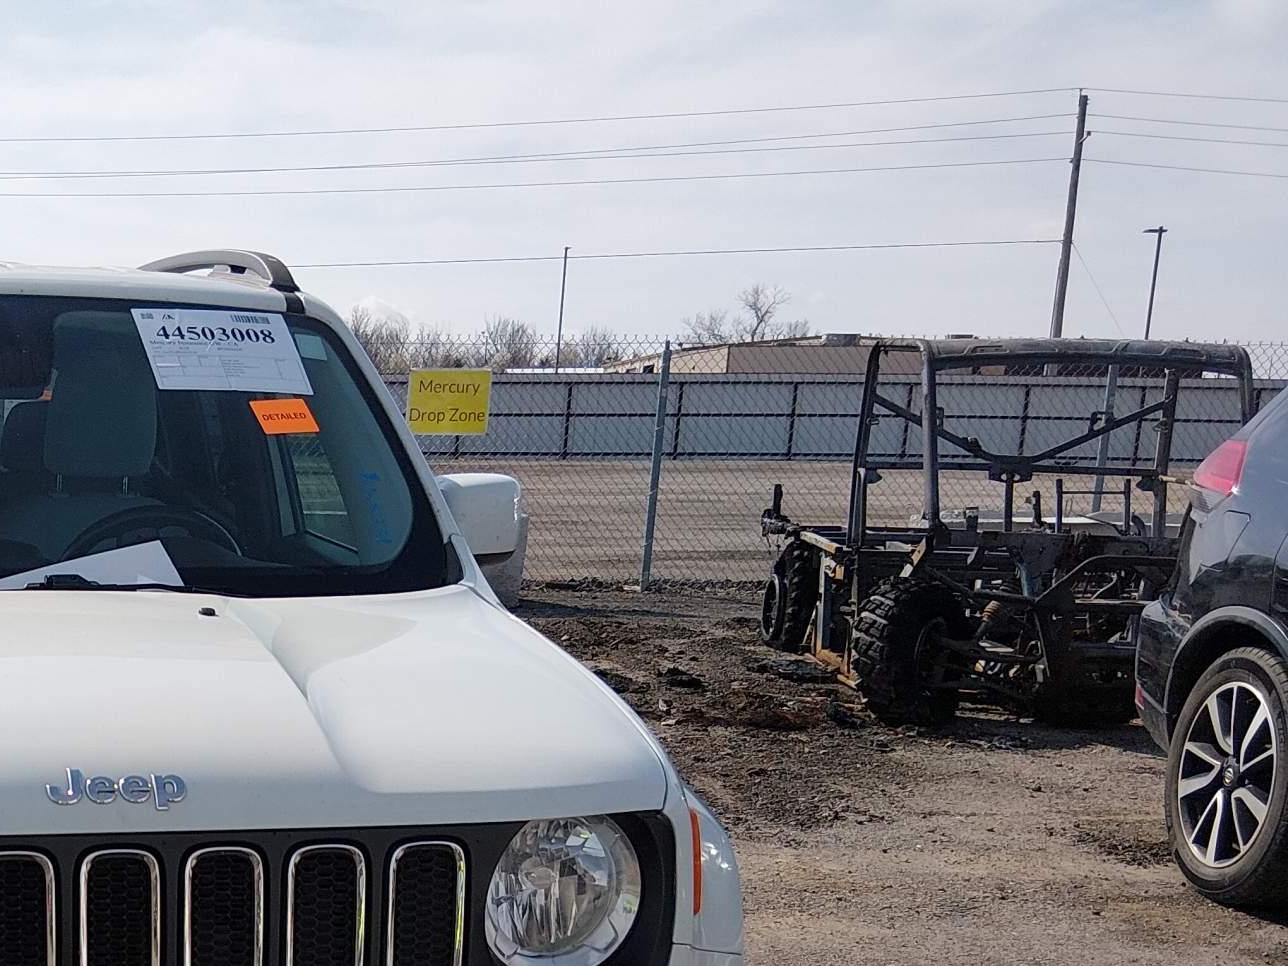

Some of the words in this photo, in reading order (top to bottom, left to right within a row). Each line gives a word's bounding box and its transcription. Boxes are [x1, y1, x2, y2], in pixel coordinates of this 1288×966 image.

[156, 325, 276, 344] 44503008
[418, 379, 481, 396] Mercury
[262, 412, 307, 421] DETAILED
[408, 407, 446, 424] Drop
[448, 407, 486, 423] Zone
[45, 767, 187, 810] Jeep
